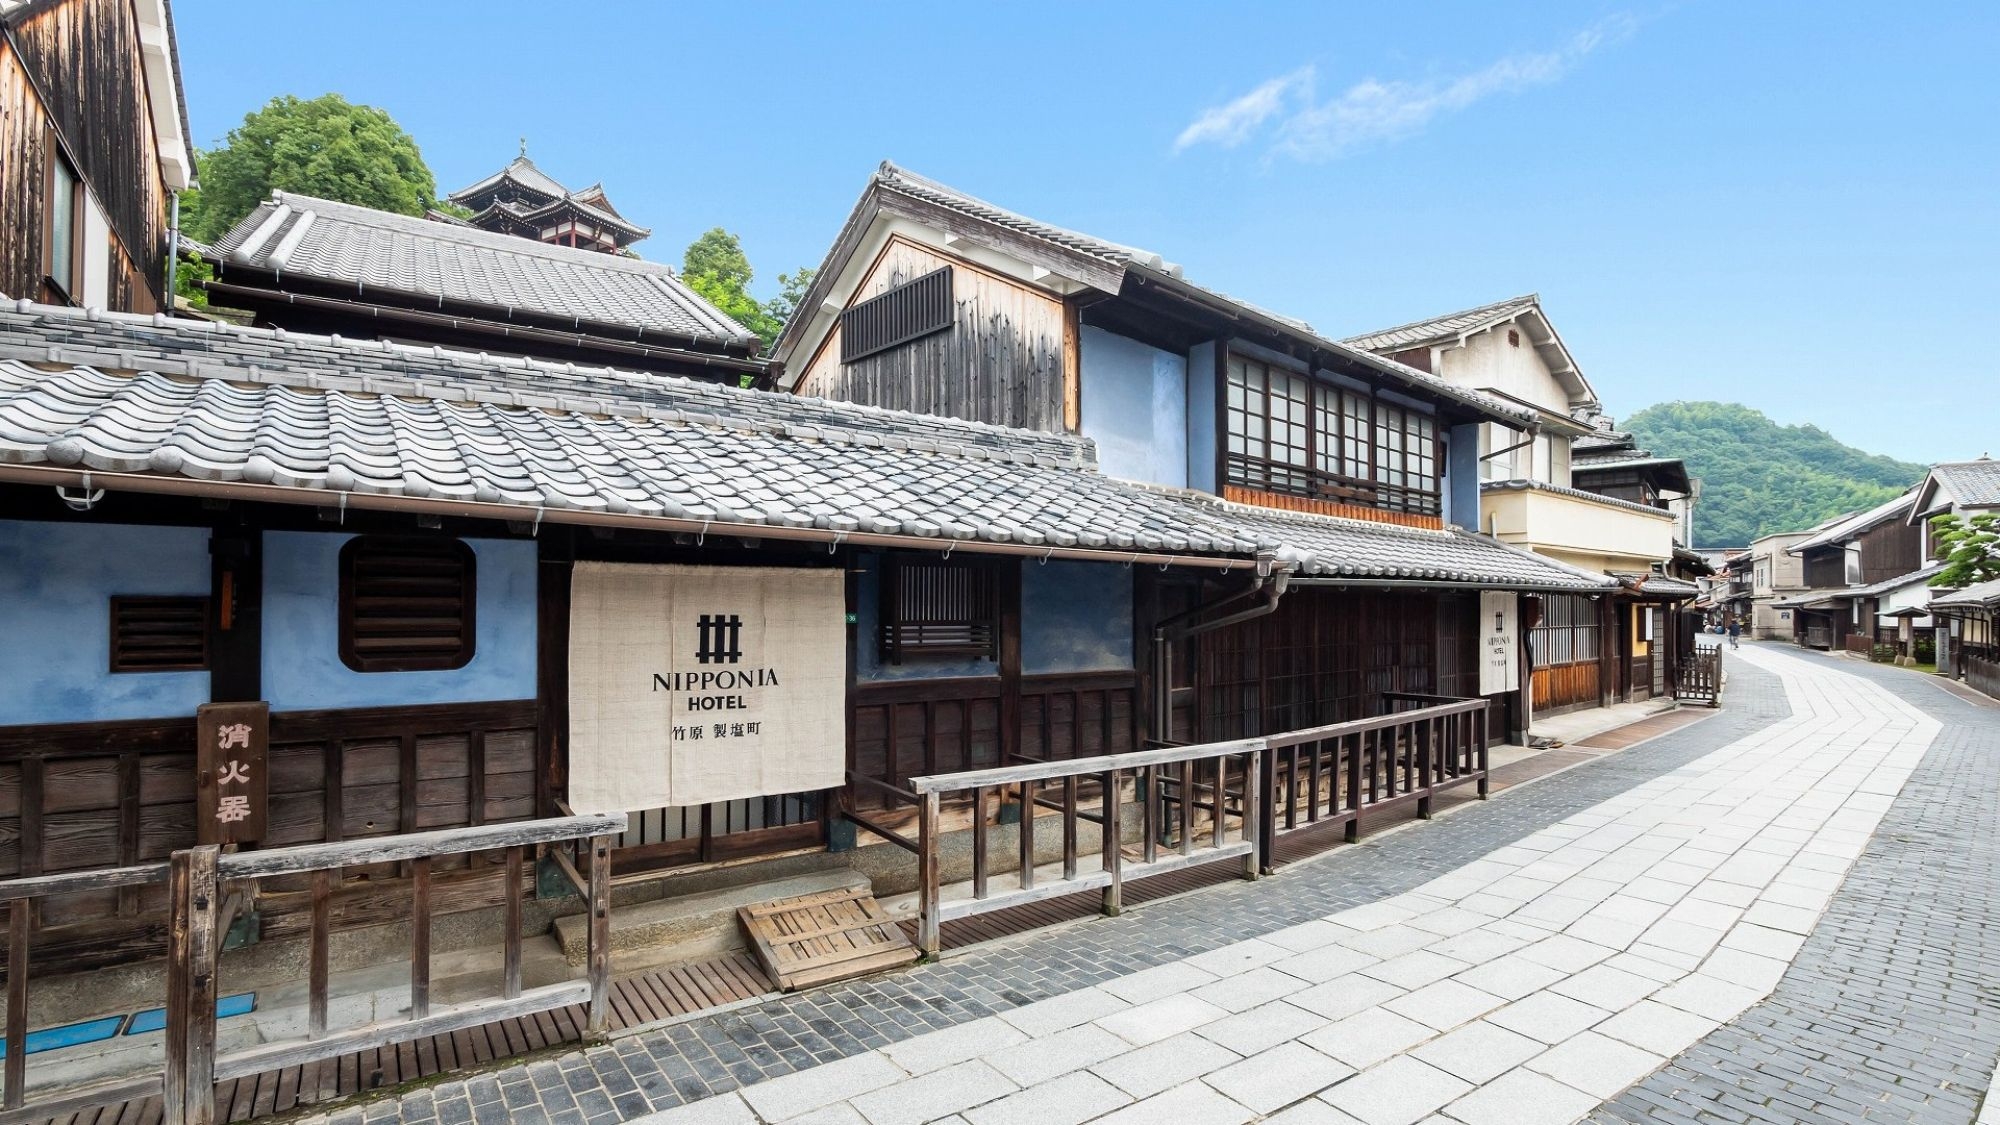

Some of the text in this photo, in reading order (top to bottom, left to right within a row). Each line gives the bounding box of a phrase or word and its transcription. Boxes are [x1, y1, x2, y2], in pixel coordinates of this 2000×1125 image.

[652, 668, 779, 691] NIPPONIA
[688, 695, 747, 711] HOTEL
[672, 721, 761, 740] 竹原 製塩町
[216, 723, 252, 823] 消火器
